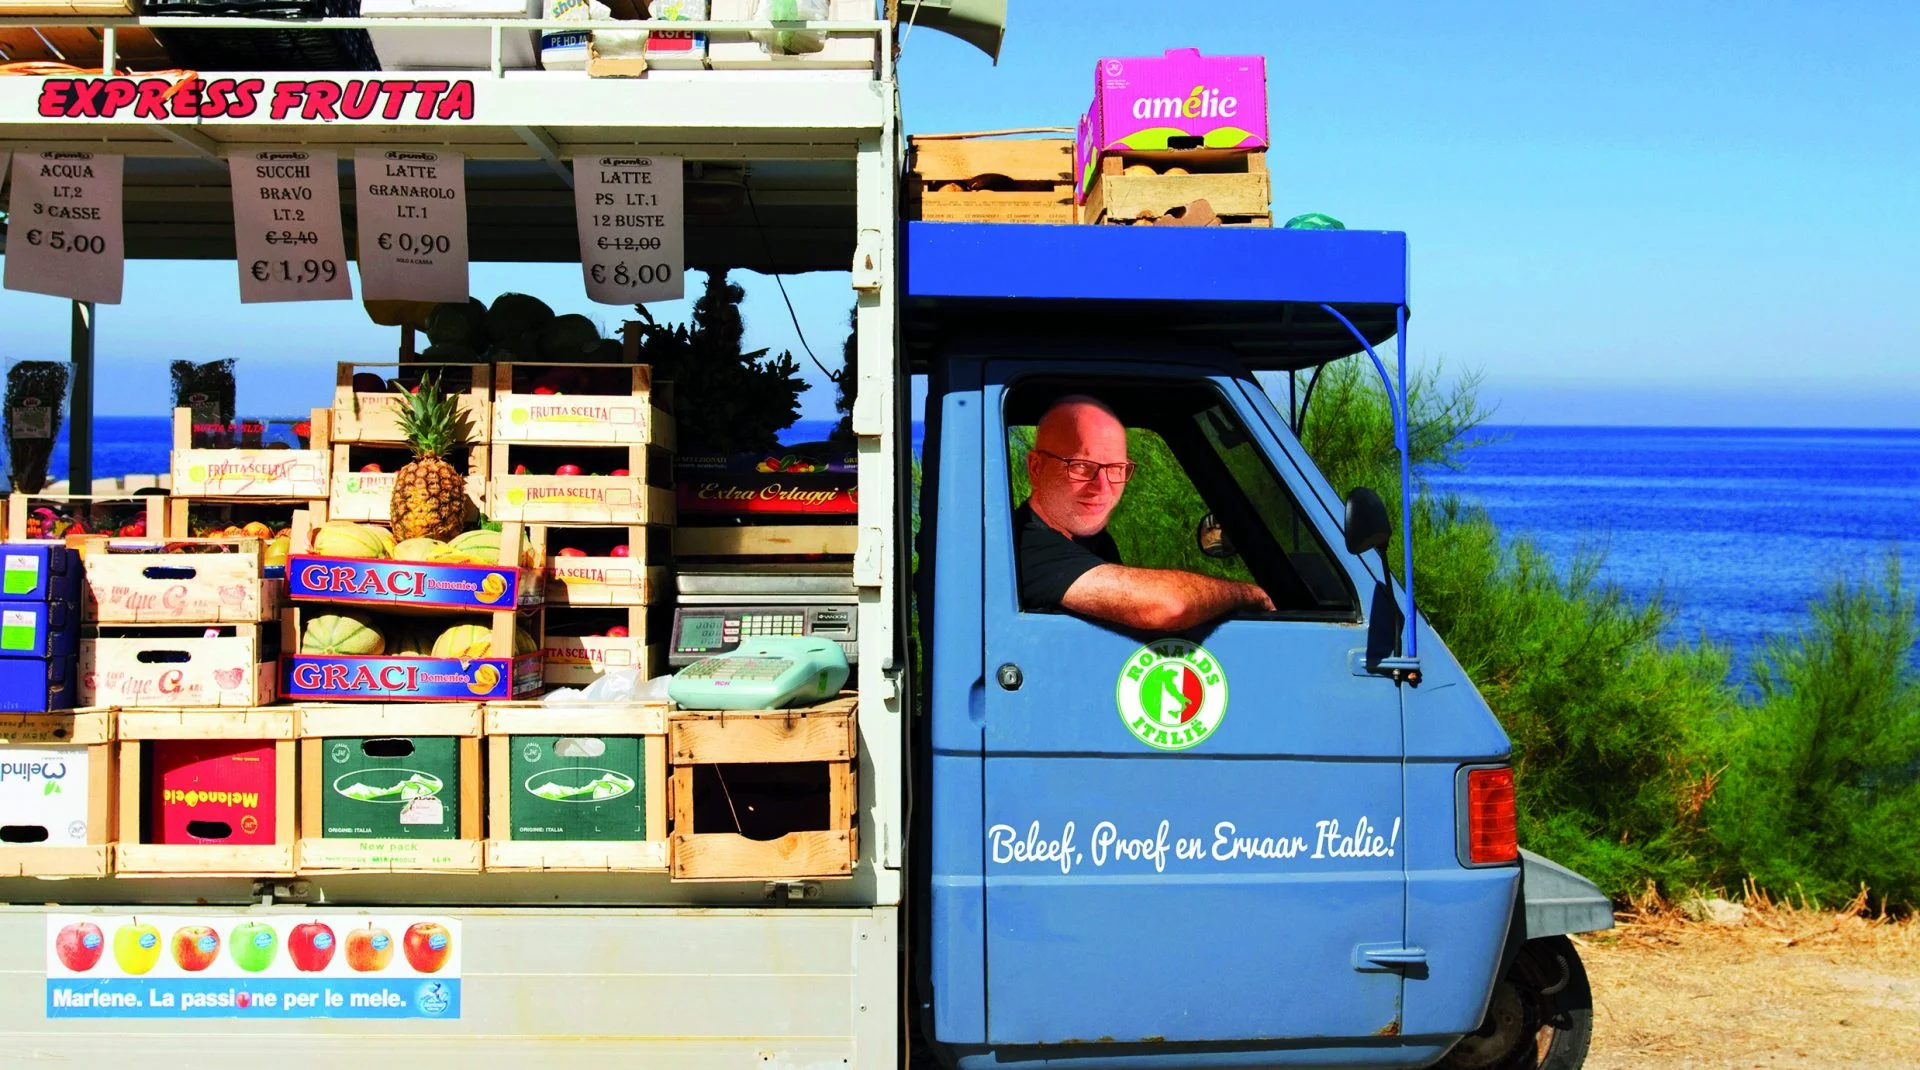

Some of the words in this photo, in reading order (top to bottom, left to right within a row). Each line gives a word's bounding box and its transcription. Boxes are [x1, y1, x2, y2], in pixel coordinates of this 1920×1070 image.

[563, 37, 576, 46] HD
[38, 78, 264, 119] EXPRESS
[270, 80, 475, 121] FRUTTA
[1133, 85, 1238, 119] amélie
[40, 164, 94, 178] ACQUA
[256, 165, 310, 178] SUCCHI
[386, 164, 437, 179] LATTE
[600, 171, 652, 184] LATTE
[260, 187, 312, 200] BRAVO
[369, 184, 455, 200] GRANAROLO
[595, 193, 614, 206] PS
[626, 193, 657, 206] LT.1
[33, 203, 43, 214] 3
[48, 206, 101, 220] CASSE
[273, 208, 305, 221] LT.2
[397, 205, 428, 219] LT.1
[593, 214, 611, 227] 12
[615, 214, 665, 227] BUSTE
[26, 229, 42, 246] €
[50, 231, 106, 254] 5,00
[265, 231, 277, 245] €
[282, 230, 318, 246] 2,40
[377, 232, 392, 250] €
[398, 233, 451, 255] 0,90
[597, 236, 608, 250] €
[614, 236, 661, 252] 12,00
[251, 260, 270, 281] €
[280, 259, 336, 283] 1,99
[590, 264, 606, 284] €
[614, 263, 671, 287] 8,00
[530, 406, 569, 420] FRUTTA
[571, 406, 608, 421] SCELTA
[208, 464, 246, 479] FRUTTA
[246, 464, 287, 478] SCELTA
[527, 487, 565, 501] FRUTTA
[567, 487, 604, 502] SCELTA
[698, 482, 755, 501] Extra
[759, 483, 839, 506] Ortaggi
[301, 564, 427, 597] GRACI
[427, 579, 478, 592] Domenico
[567, 568, 604, 583] SCELTA
[565, 648, 603, 663] SCELTA
[1127, 645, 1220, 686] RONALDS
[293, 662, 420, 691] GRACI
[420, 673, 470, 684] Domenico
[1132, 716, 1207, 745] ITALIË
[0, 763, 66, 782] Melind
[359, 842, 385, 851] New
[390, 842, 418, 853] pack
[989, 820, 1083, 874] Beleef,
[1091, 820, 1170, 873] Proef
[1176, 837, 1206, 860] en
[1211, 821, 1308, 861] Ervaar
[1310, 816, 1401, 860] Italie!
[53, 988, 143, 1008] Marlene.
[150, 988, 174, 1007] La
[181, 988, 277, 1011] passine
[283, 992, 319, 1011] per
[325, 988, 344, 1007] le
[350, 988, 407, 1007] mele.
